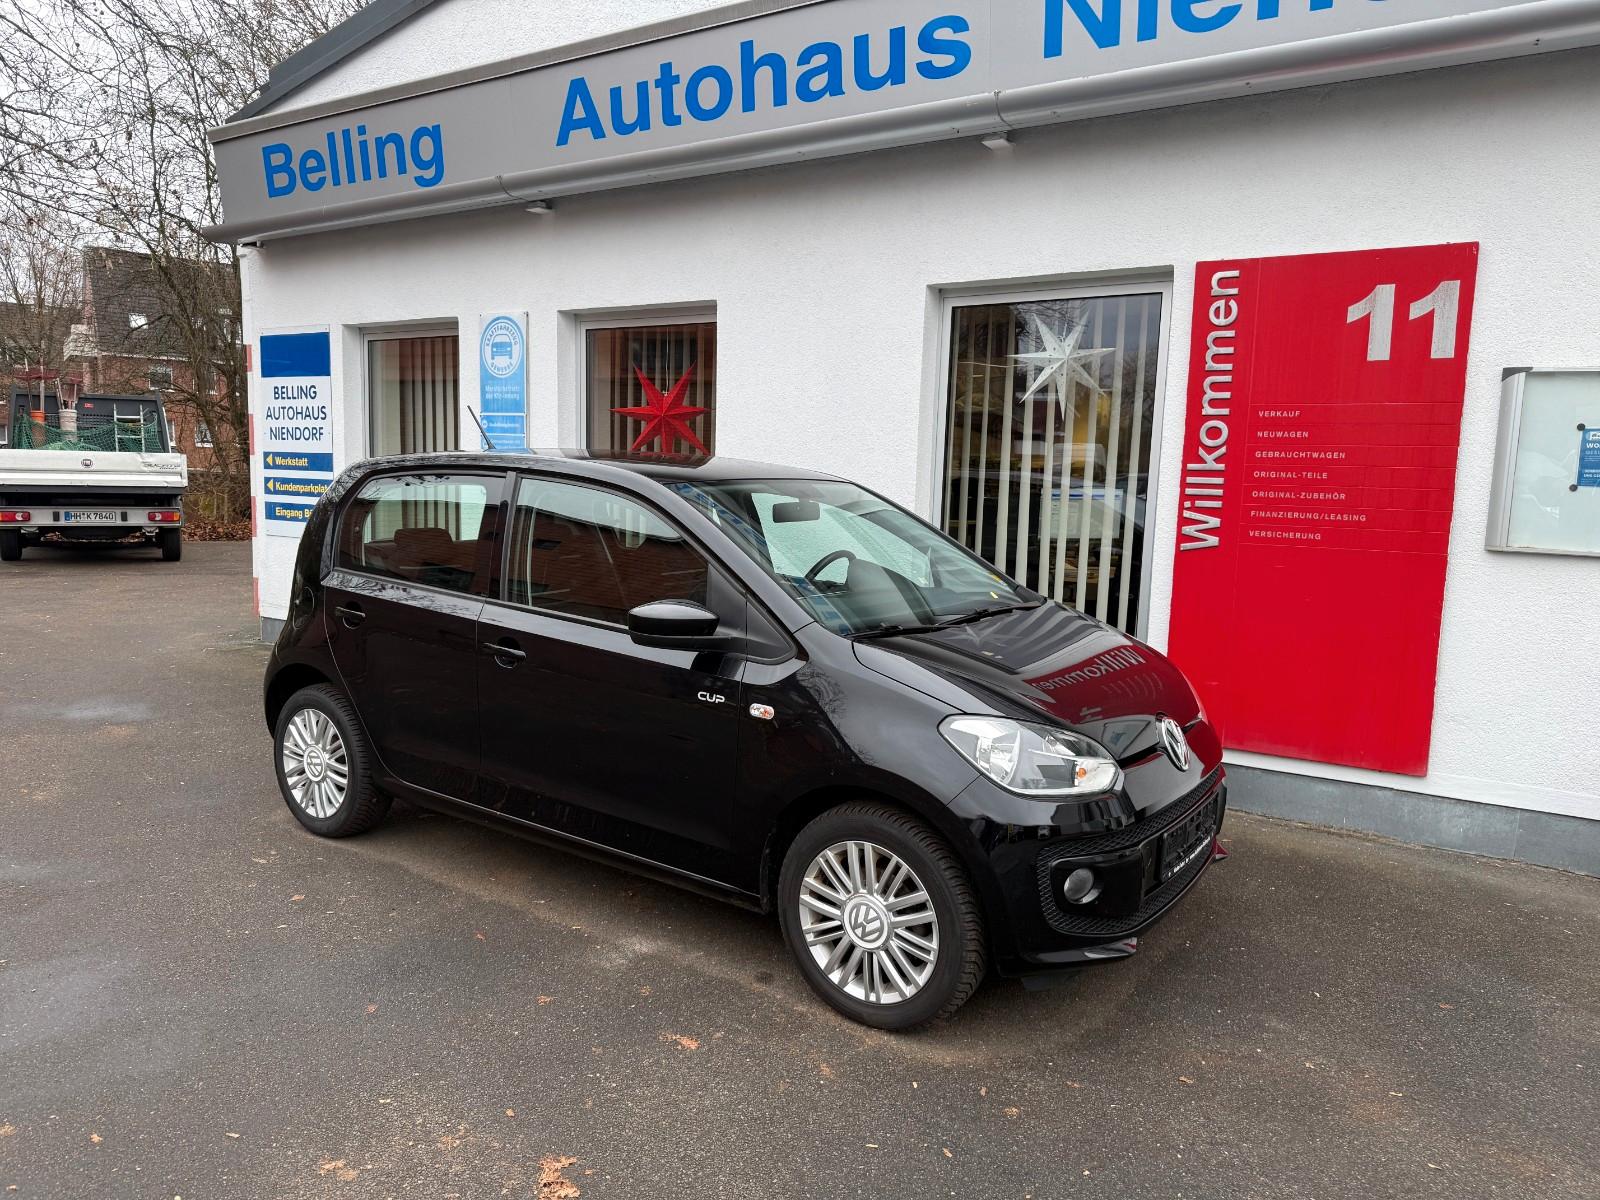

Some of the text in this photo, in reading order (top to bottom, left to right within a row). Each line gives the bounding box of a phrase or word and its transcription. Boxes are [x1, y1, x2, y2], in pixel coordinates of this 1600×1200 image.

[262, 124, 445, 197] Belling
[556, 15, 972, 147] Autohaus
[1346, 279, 1461, 361] 11
[273, 385, 317, 400] BELLING
[266, 406, 327, 420] AUTOHAUS
[1180, 269, 1240, 551] Willkommen
[1258, 410, 1301, 418] VERKAUF
[270, 426, 324, 441] NIENDORF
[1257, 430, 1309, 438] NEUWAGEN
[274, 456, 308, 467] Werkstatt
[1255, 451, 1346, 459] GEBRAUCHTWAGEN
[1253, 471, 1328, 479] ORIGINAL-TEILE
[275, 481, 328, 495] Kundenparkplat
[1252, 490, 1346, 500] ORIGINAL-ZUBEHÖR
[275, 506, 303, 519] Eingang
[1250, 510, 1367, 522] FINANZIERUNG/LEASING
[1249, 530, 1322, 540] VERSICHERUNG
[697, 691, 725, 704] CUP
